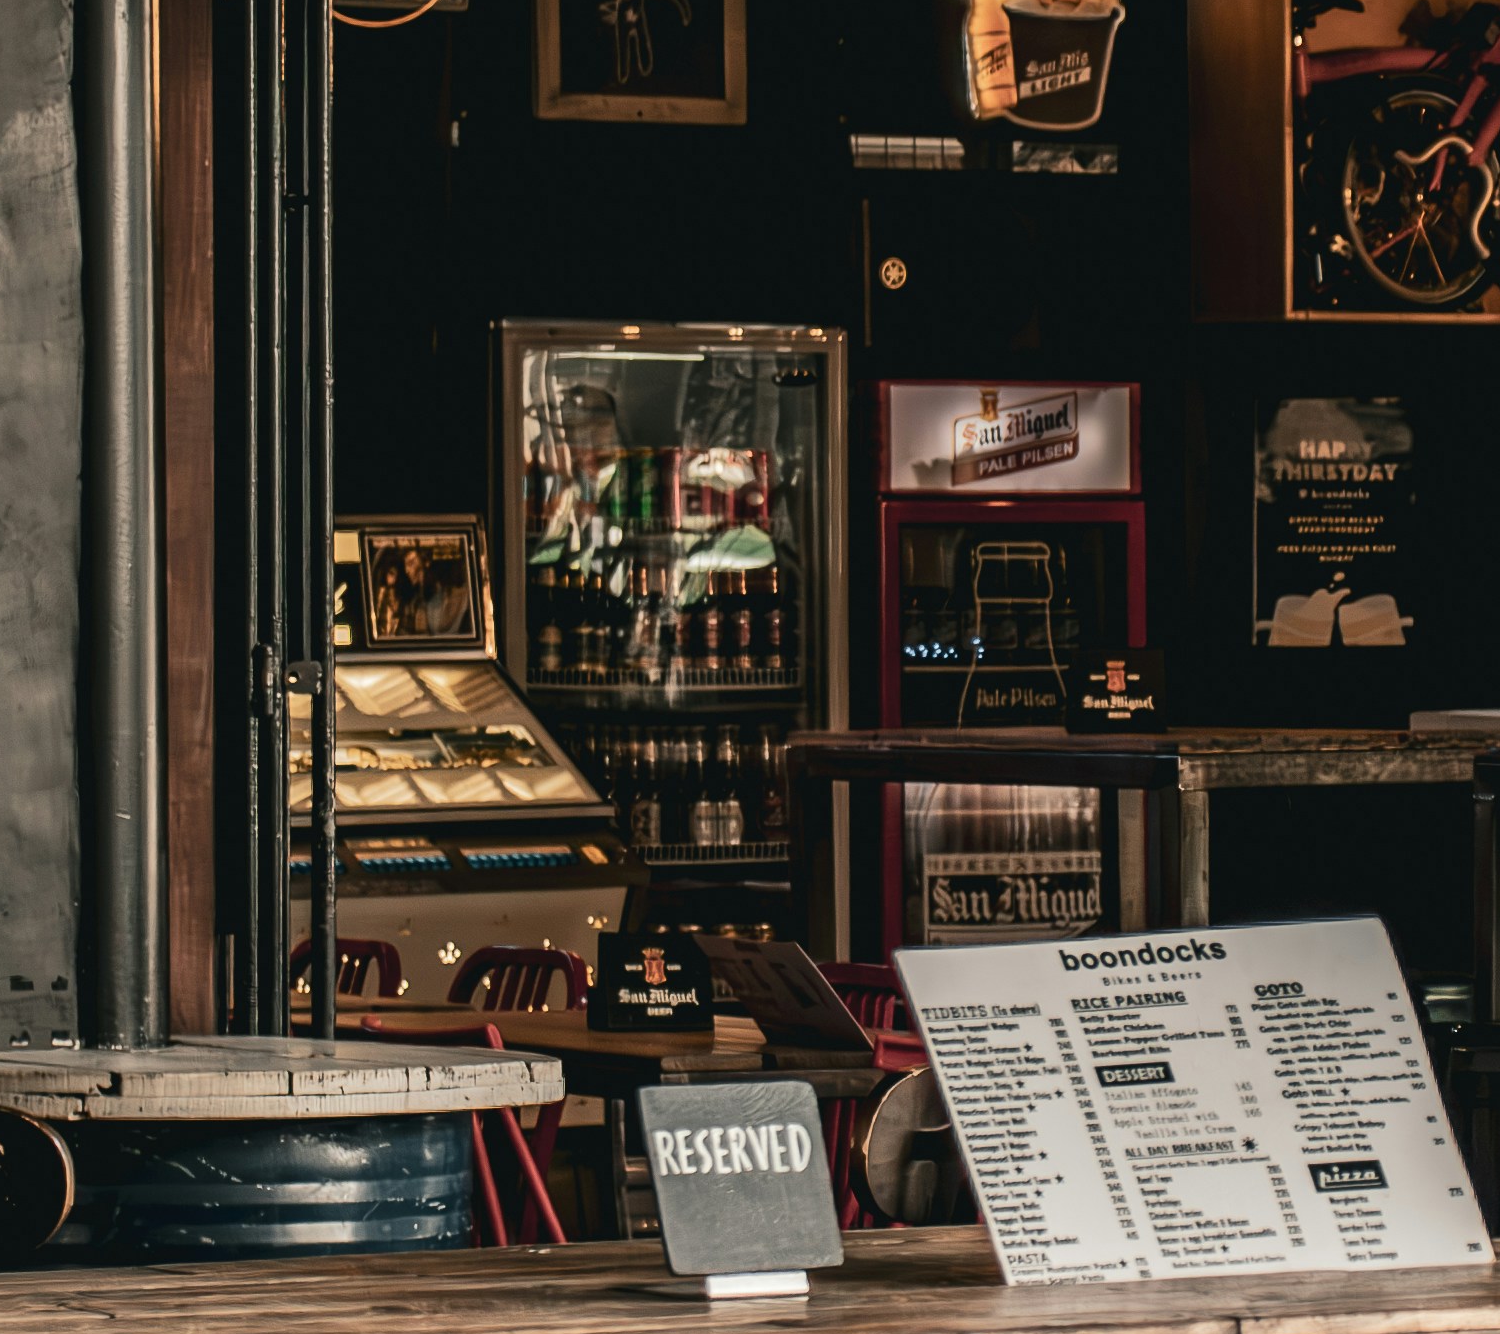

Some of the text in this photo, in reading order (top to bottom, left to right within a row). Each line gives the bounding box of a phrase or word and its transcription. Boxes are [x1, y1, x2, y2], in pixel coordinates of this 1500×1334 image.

[963, 402, 1072, 452] San Miguel
[979, 441, 1074, 476] PALE PILSEN
[1300, 440, 1375, 460] HAPY
[976, 687, 1007, 710] Pale
[1110, 694, 1155, 712] Miguel
[932, 871, 1102, 929] San Miguel
[1058, 937, 1227, 972] boondocks
[1101, 975, 1142, 986] Bikes
[1159, 969, 1203, 981] Beers
[618, 987, 700, 1007] San Miguel
[1251, 981, 1305, 997] GOTO
[1069, 990, 1188, 1010] RICE PAIRING
[920, 1004, 989, 1021] TIDBITS
[1100, 1066, 1168, 1083] DESSERT
[654, 1123, 812, 1176] RESERVED
[1122, 1140, 1237, 1158] ALL DAY BREAKFAST
[1313, 1163, 1383, 1189] pizza
[1005, 1252, 1051, 1265] PASTA
